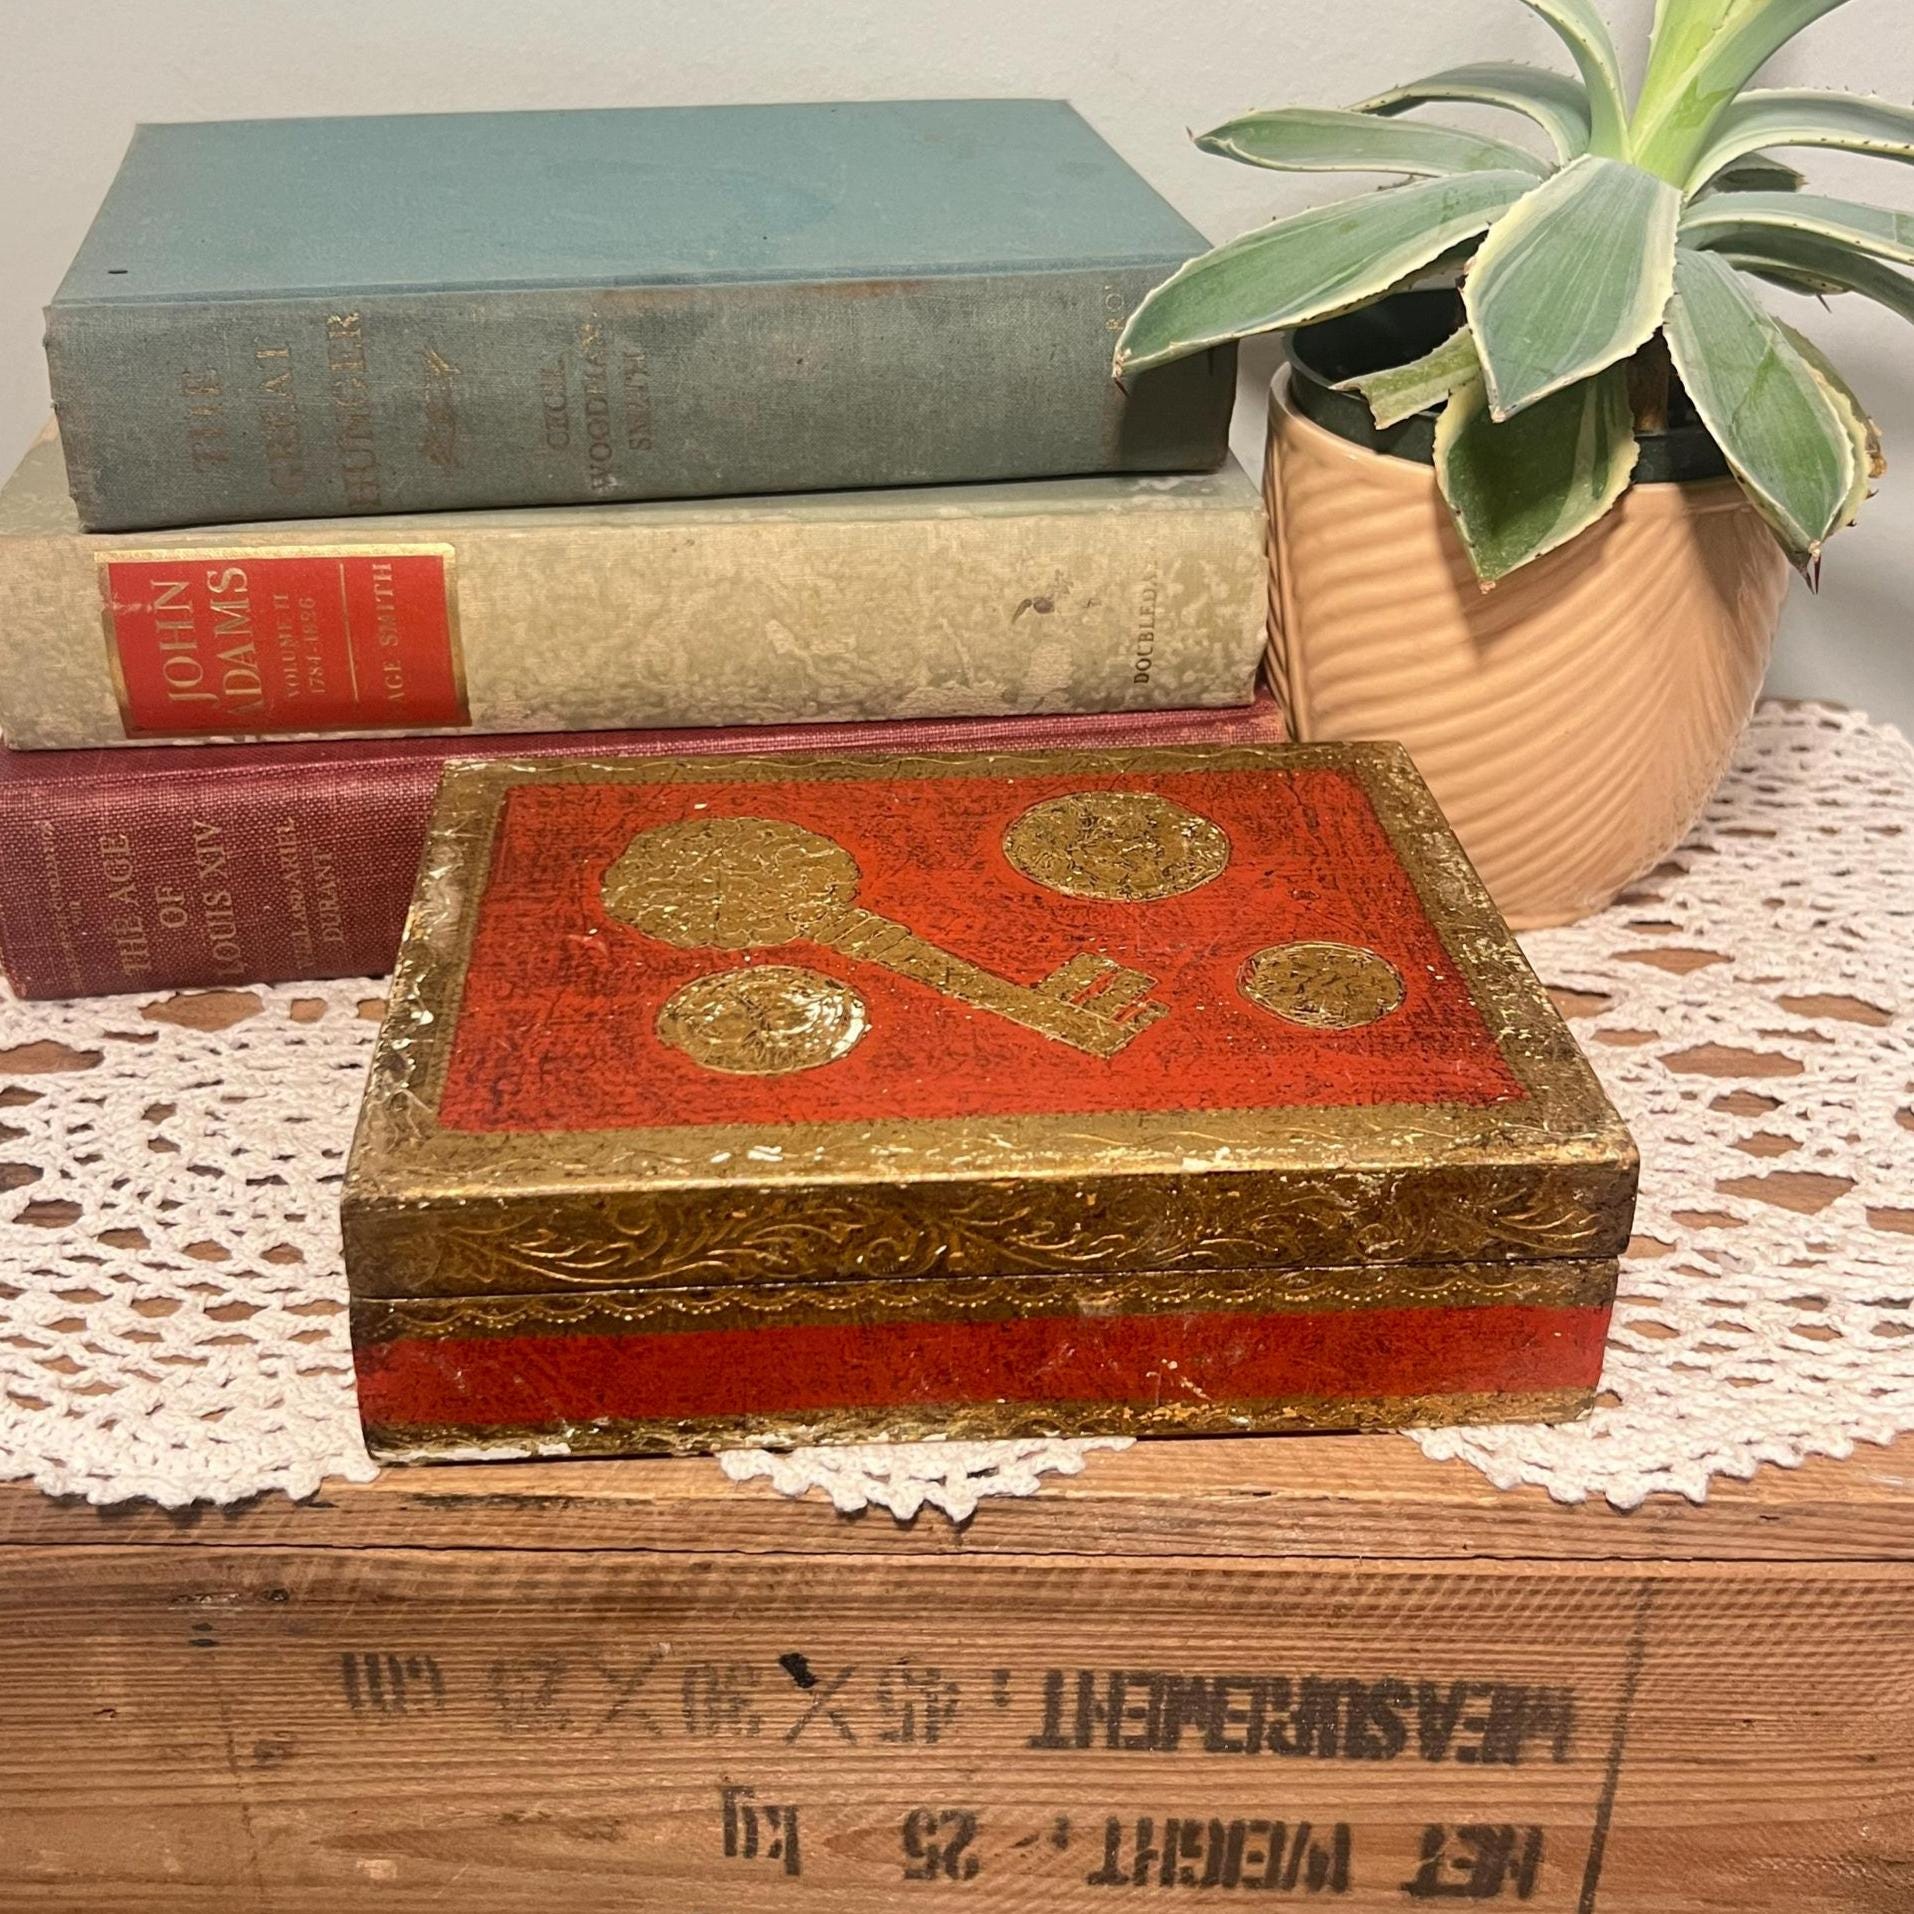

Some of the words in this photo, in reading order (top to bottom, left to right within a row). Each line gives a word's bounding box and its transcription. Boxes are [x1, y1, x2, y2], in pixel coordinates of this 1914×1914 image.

[325, 311, 381, 508] HUNGER
[151, 579, 219, 707] JOHN
[206, 566, 265, 718] ADAMS
[371, 563, 399, 647] SMITH
[277, 622, 300, 697] VOLUME
[99, 834, 141, 906] AGE
[192, 817, 229, 878] XIV
[276, 816, 303, 884] ARIEL
[154, 886, 190, 929] OF
[200, 889, 246, 976] LOUIS
[311, 847, 344, 942] DURANT
[112, 915, 152, 976] THE
[1026, 1668, 1576, 1764] MEASUREMENT
[722, 1786, 800, 1877] kg
[902, 1807, 980, 1881] 25
[1087, 1815, 1352, 1892] WEIGHT
[1400, 1822, 1544, 1899] NET
